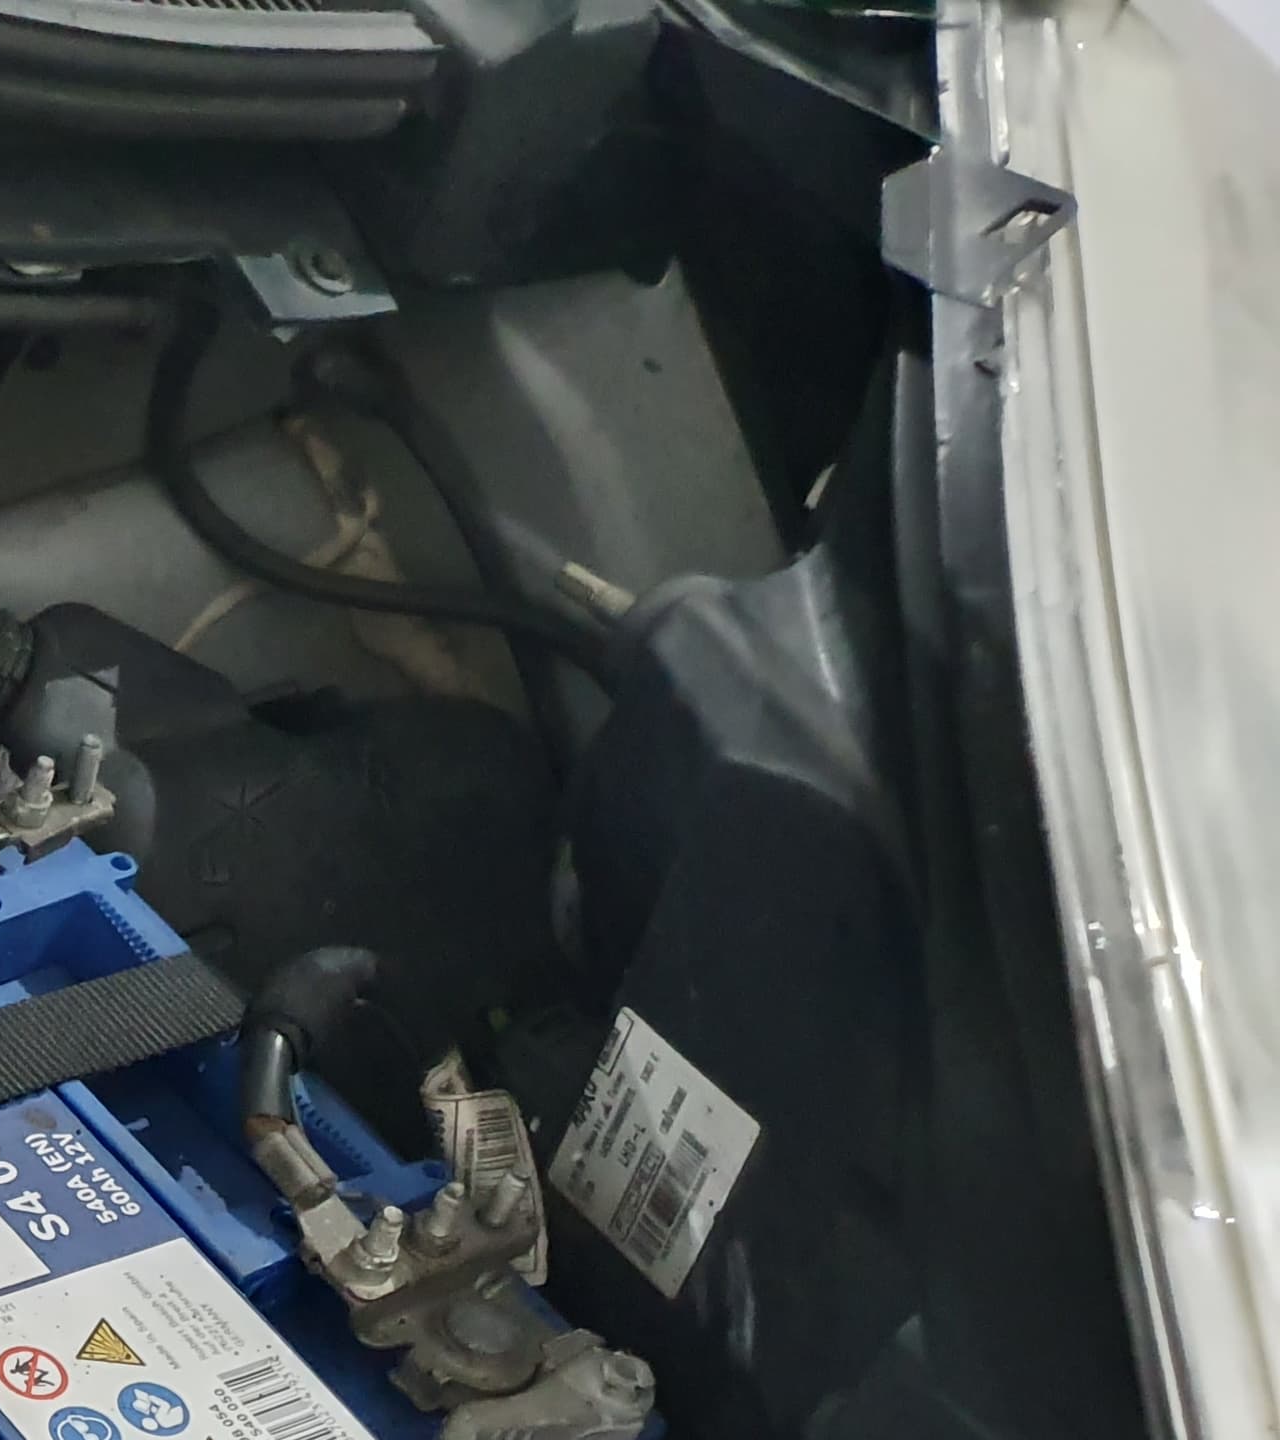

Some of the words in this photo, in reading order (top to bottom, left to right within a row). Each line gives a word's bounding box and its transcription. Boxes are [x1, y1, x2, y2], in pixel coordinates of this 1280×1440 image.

[24, 1133, 72, 1172] (EN)
[52, 1133, 95, 1165] 12V
[66, 1174, 118, 1224] 540A
[91, 1167, 141, 1216] 60Ah
[6, 1191, 70, 1241] S4
[209, 1404, 234, 1428] 054
[214, 1388, 239, 1412] 050
